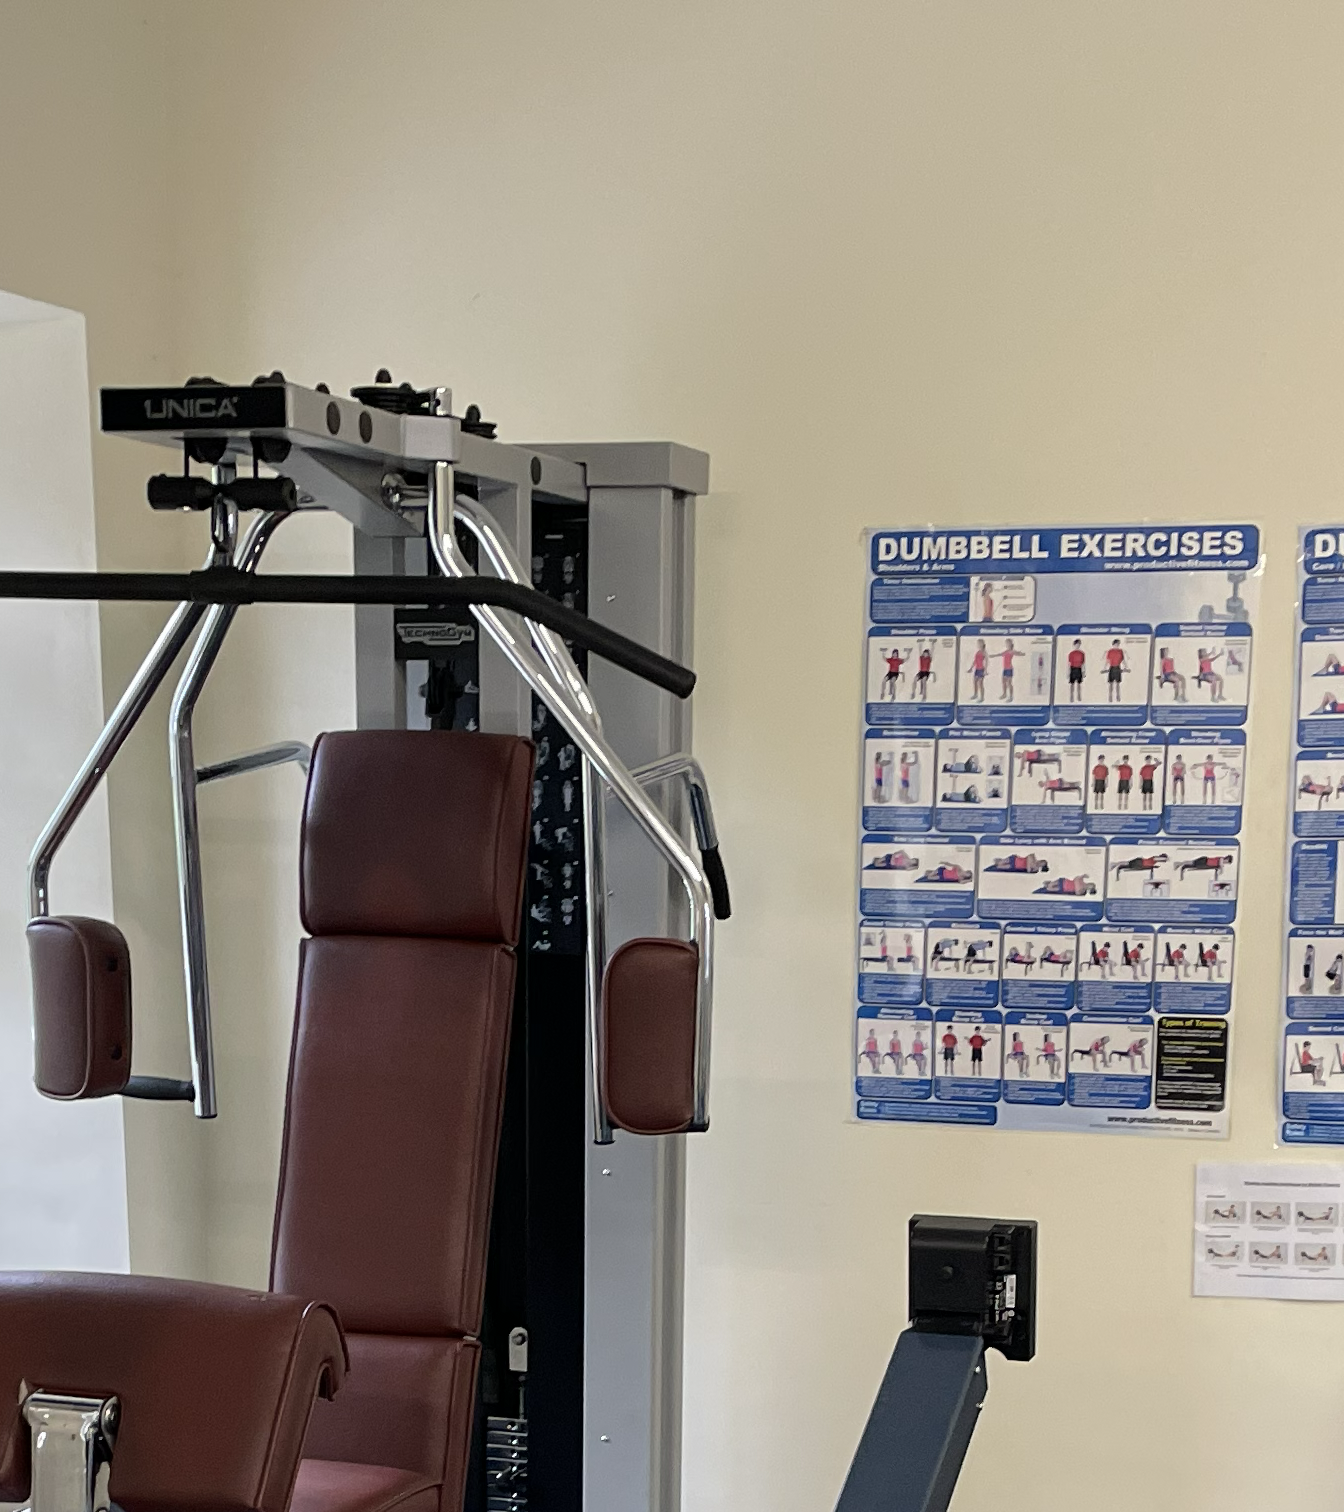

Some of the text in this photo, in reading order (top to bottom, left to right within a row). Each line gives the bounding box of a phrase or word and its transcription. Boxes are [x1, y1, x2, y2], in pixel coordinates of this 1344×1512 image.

[144, 397, 239, 419] UNICA
[877, 529, 1246, 562] DUMBBELL EXERCISES
